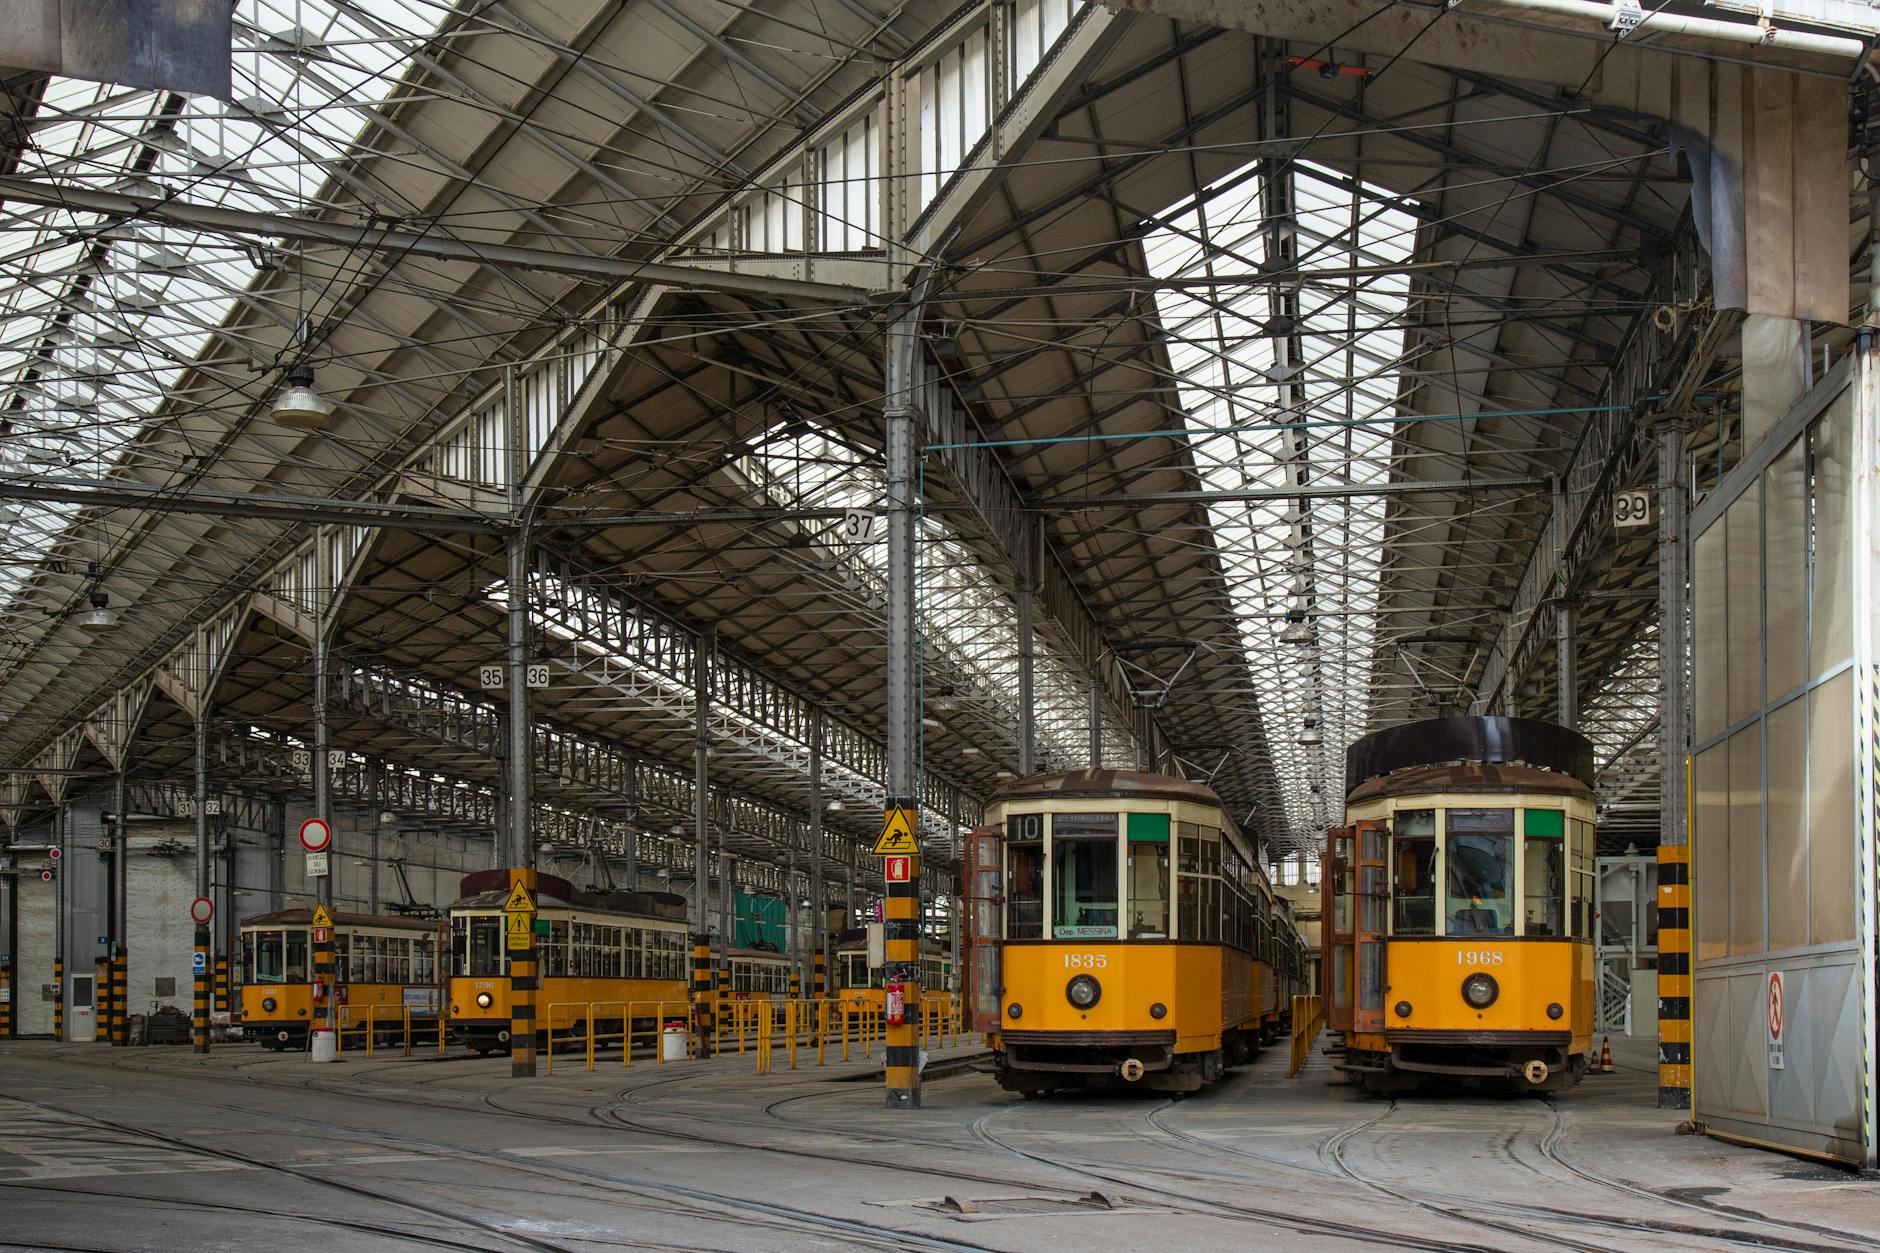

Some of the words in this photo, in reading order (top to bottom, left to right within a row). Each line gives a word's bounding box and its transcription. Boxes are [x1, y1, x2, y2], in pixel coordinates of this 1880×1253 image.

[1615, 496, 1647, 522] 39
[847, 513, 873, 539] 37
[482, 669, 502, 686] 35
[528, 668, 548, 684] 36
[293, 752, 310, 766] 33
[328, 752, 344, 766] 34
[179, 803, 191, 814] 31
[206, 802, 219, 814] 32
[1015, 815, 1039, 840] 10
[99, 839, 111, 848] 30
[1077, 926, 1113, 936] MESSINA
[1064, 953, 1108, 969] 1835
[1457, 950, 1503, 966] 1968
